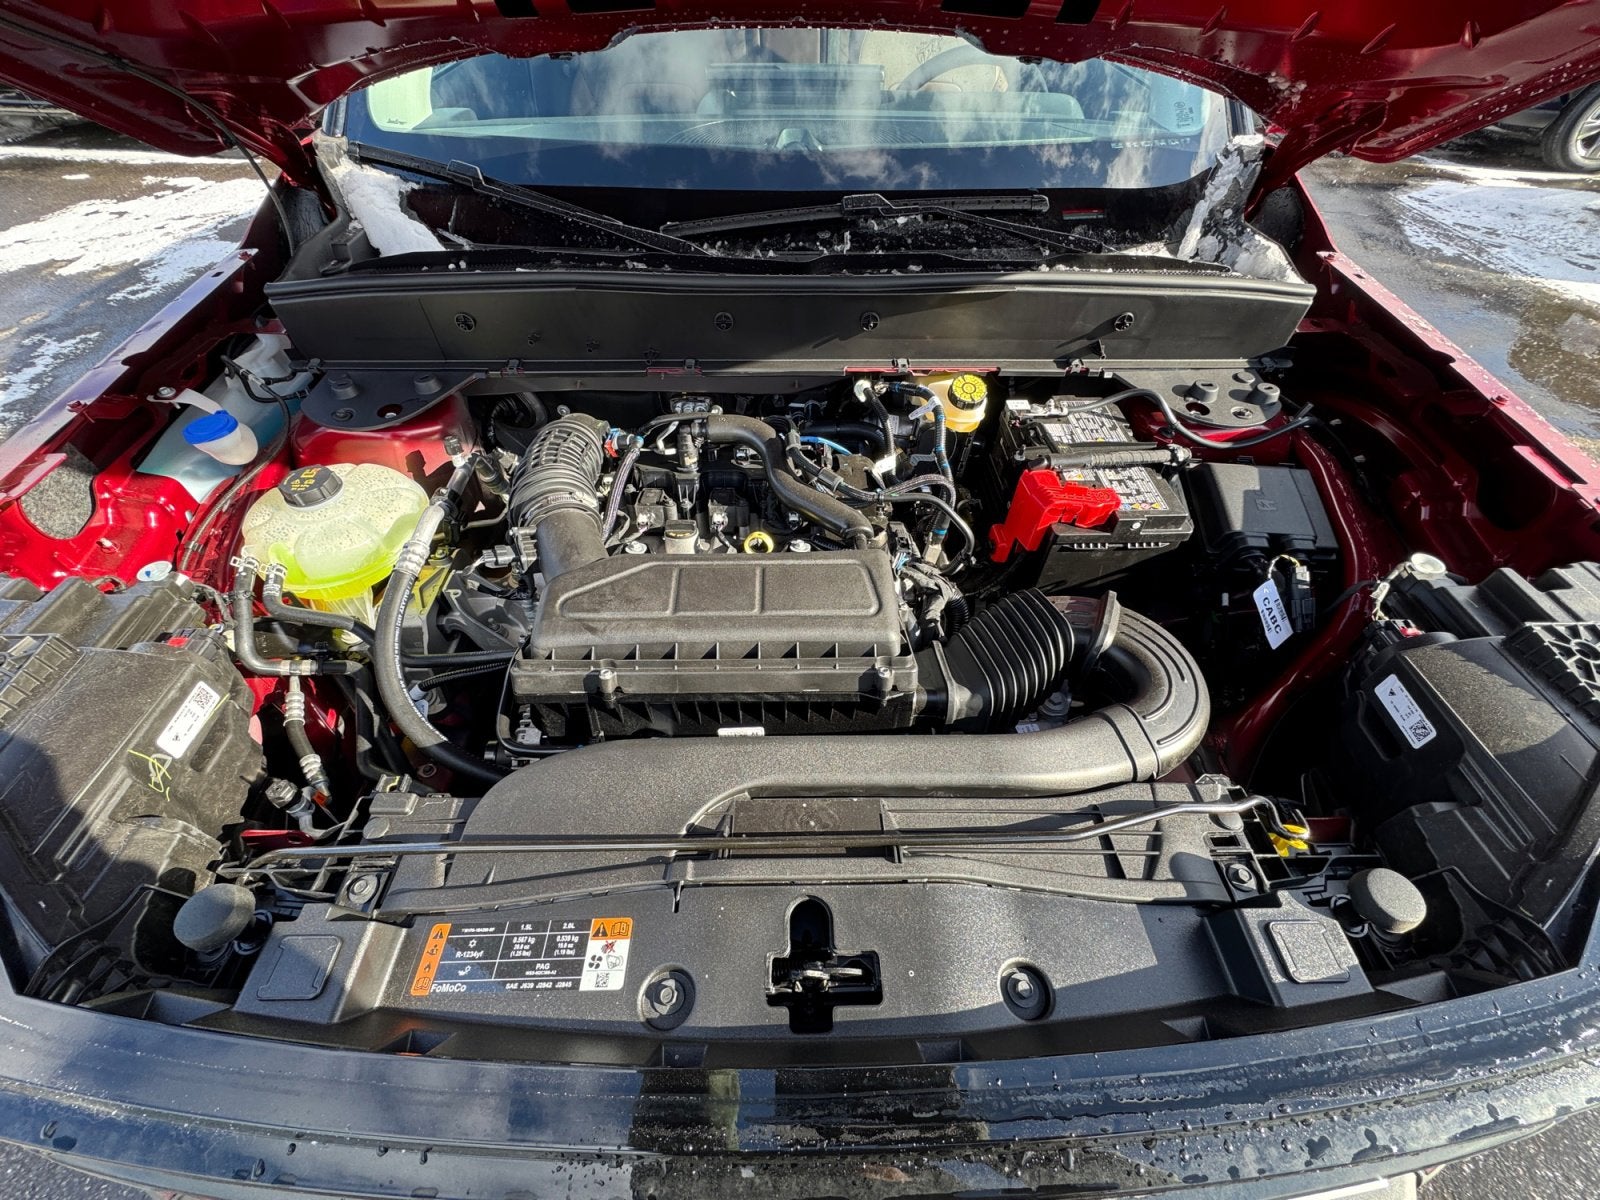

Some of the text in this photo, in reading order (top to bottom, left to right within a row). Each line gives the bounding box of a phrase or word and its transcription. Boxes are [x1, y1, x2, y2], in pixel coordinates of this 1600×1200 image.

[1262, 596, 1282, 634] CABC
[528, 935, 536, 944] kg
[571, 934, 579, 943] kg
[455, 950, 484, 959] R-1234yf
[535, 962, 551, 970] PAG
[430, 982, 467, 993] FoMoCo
[505, 982, 519, 990] SAE
